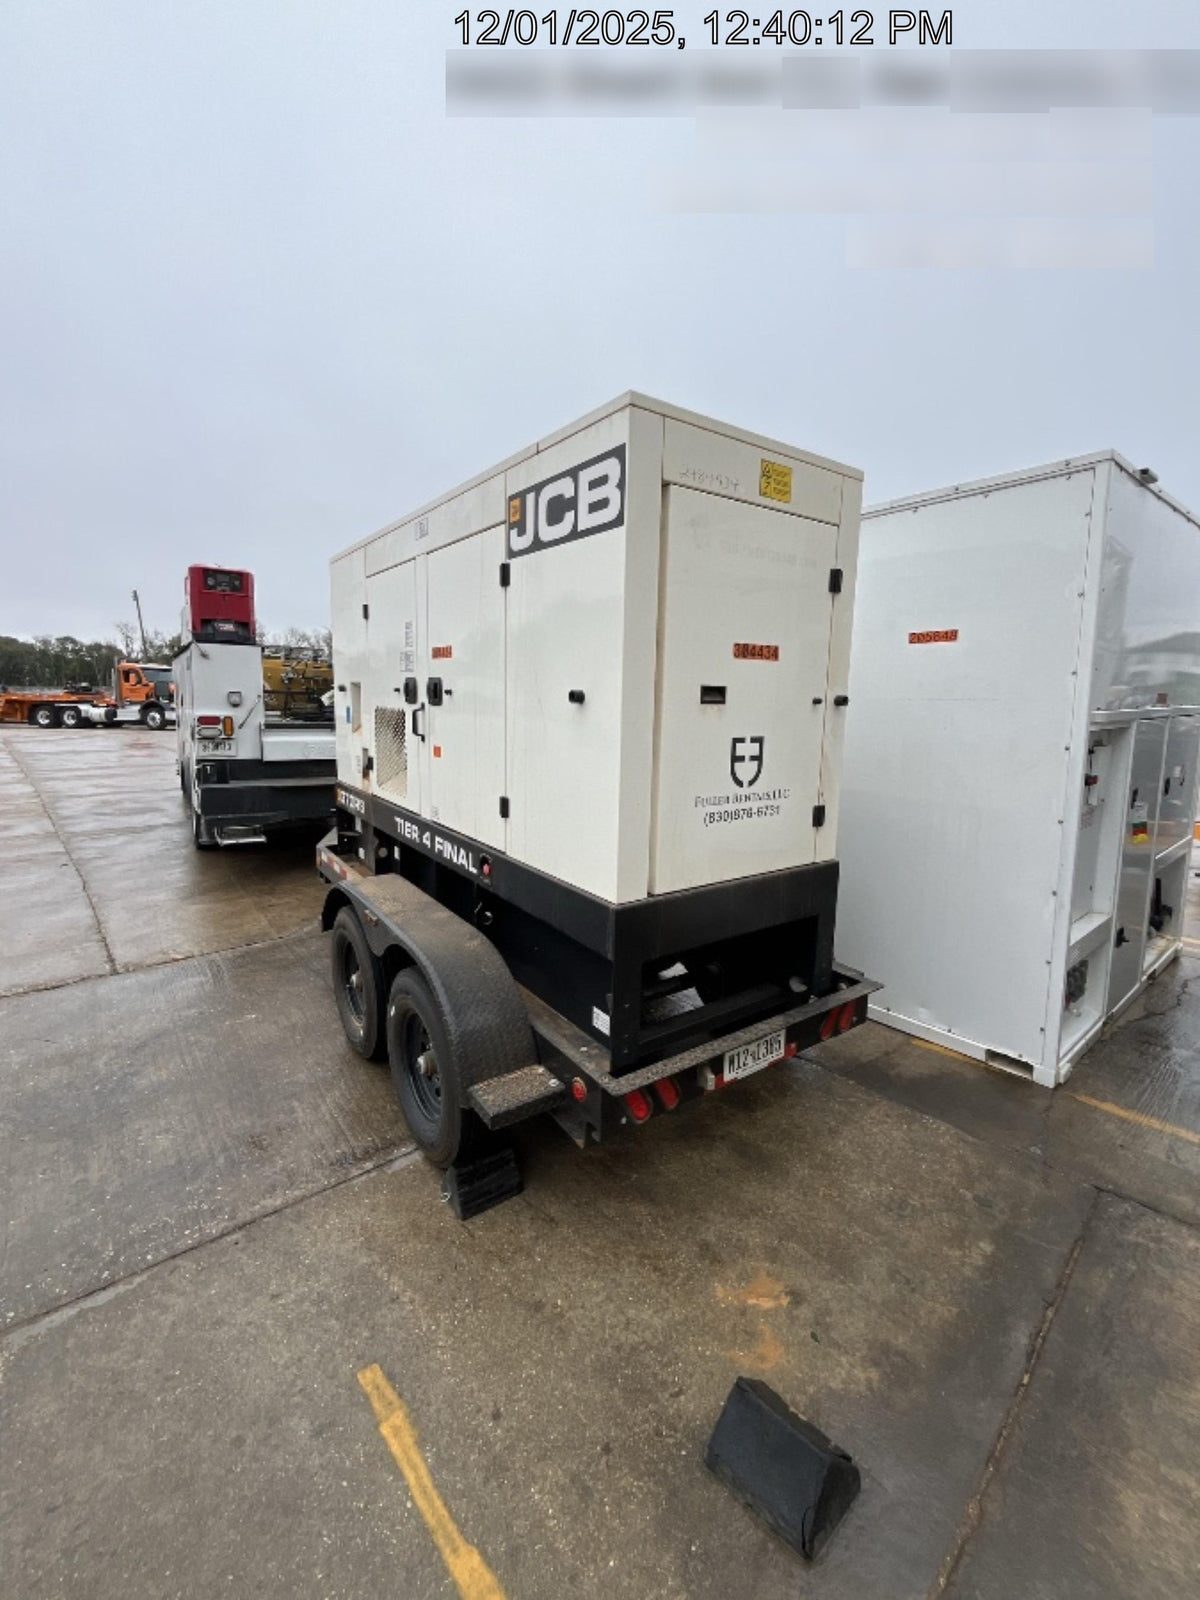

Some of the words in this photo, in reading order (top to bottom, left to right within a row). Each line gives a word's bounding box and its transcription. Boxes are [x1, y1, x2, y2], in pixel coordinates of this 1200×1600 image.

[509, 455, 622, 552] JCB
[394, 816, 420, 843] TIER
[422, 831, 431, 849] 4
[435, 835, 478, 874] FINAL
